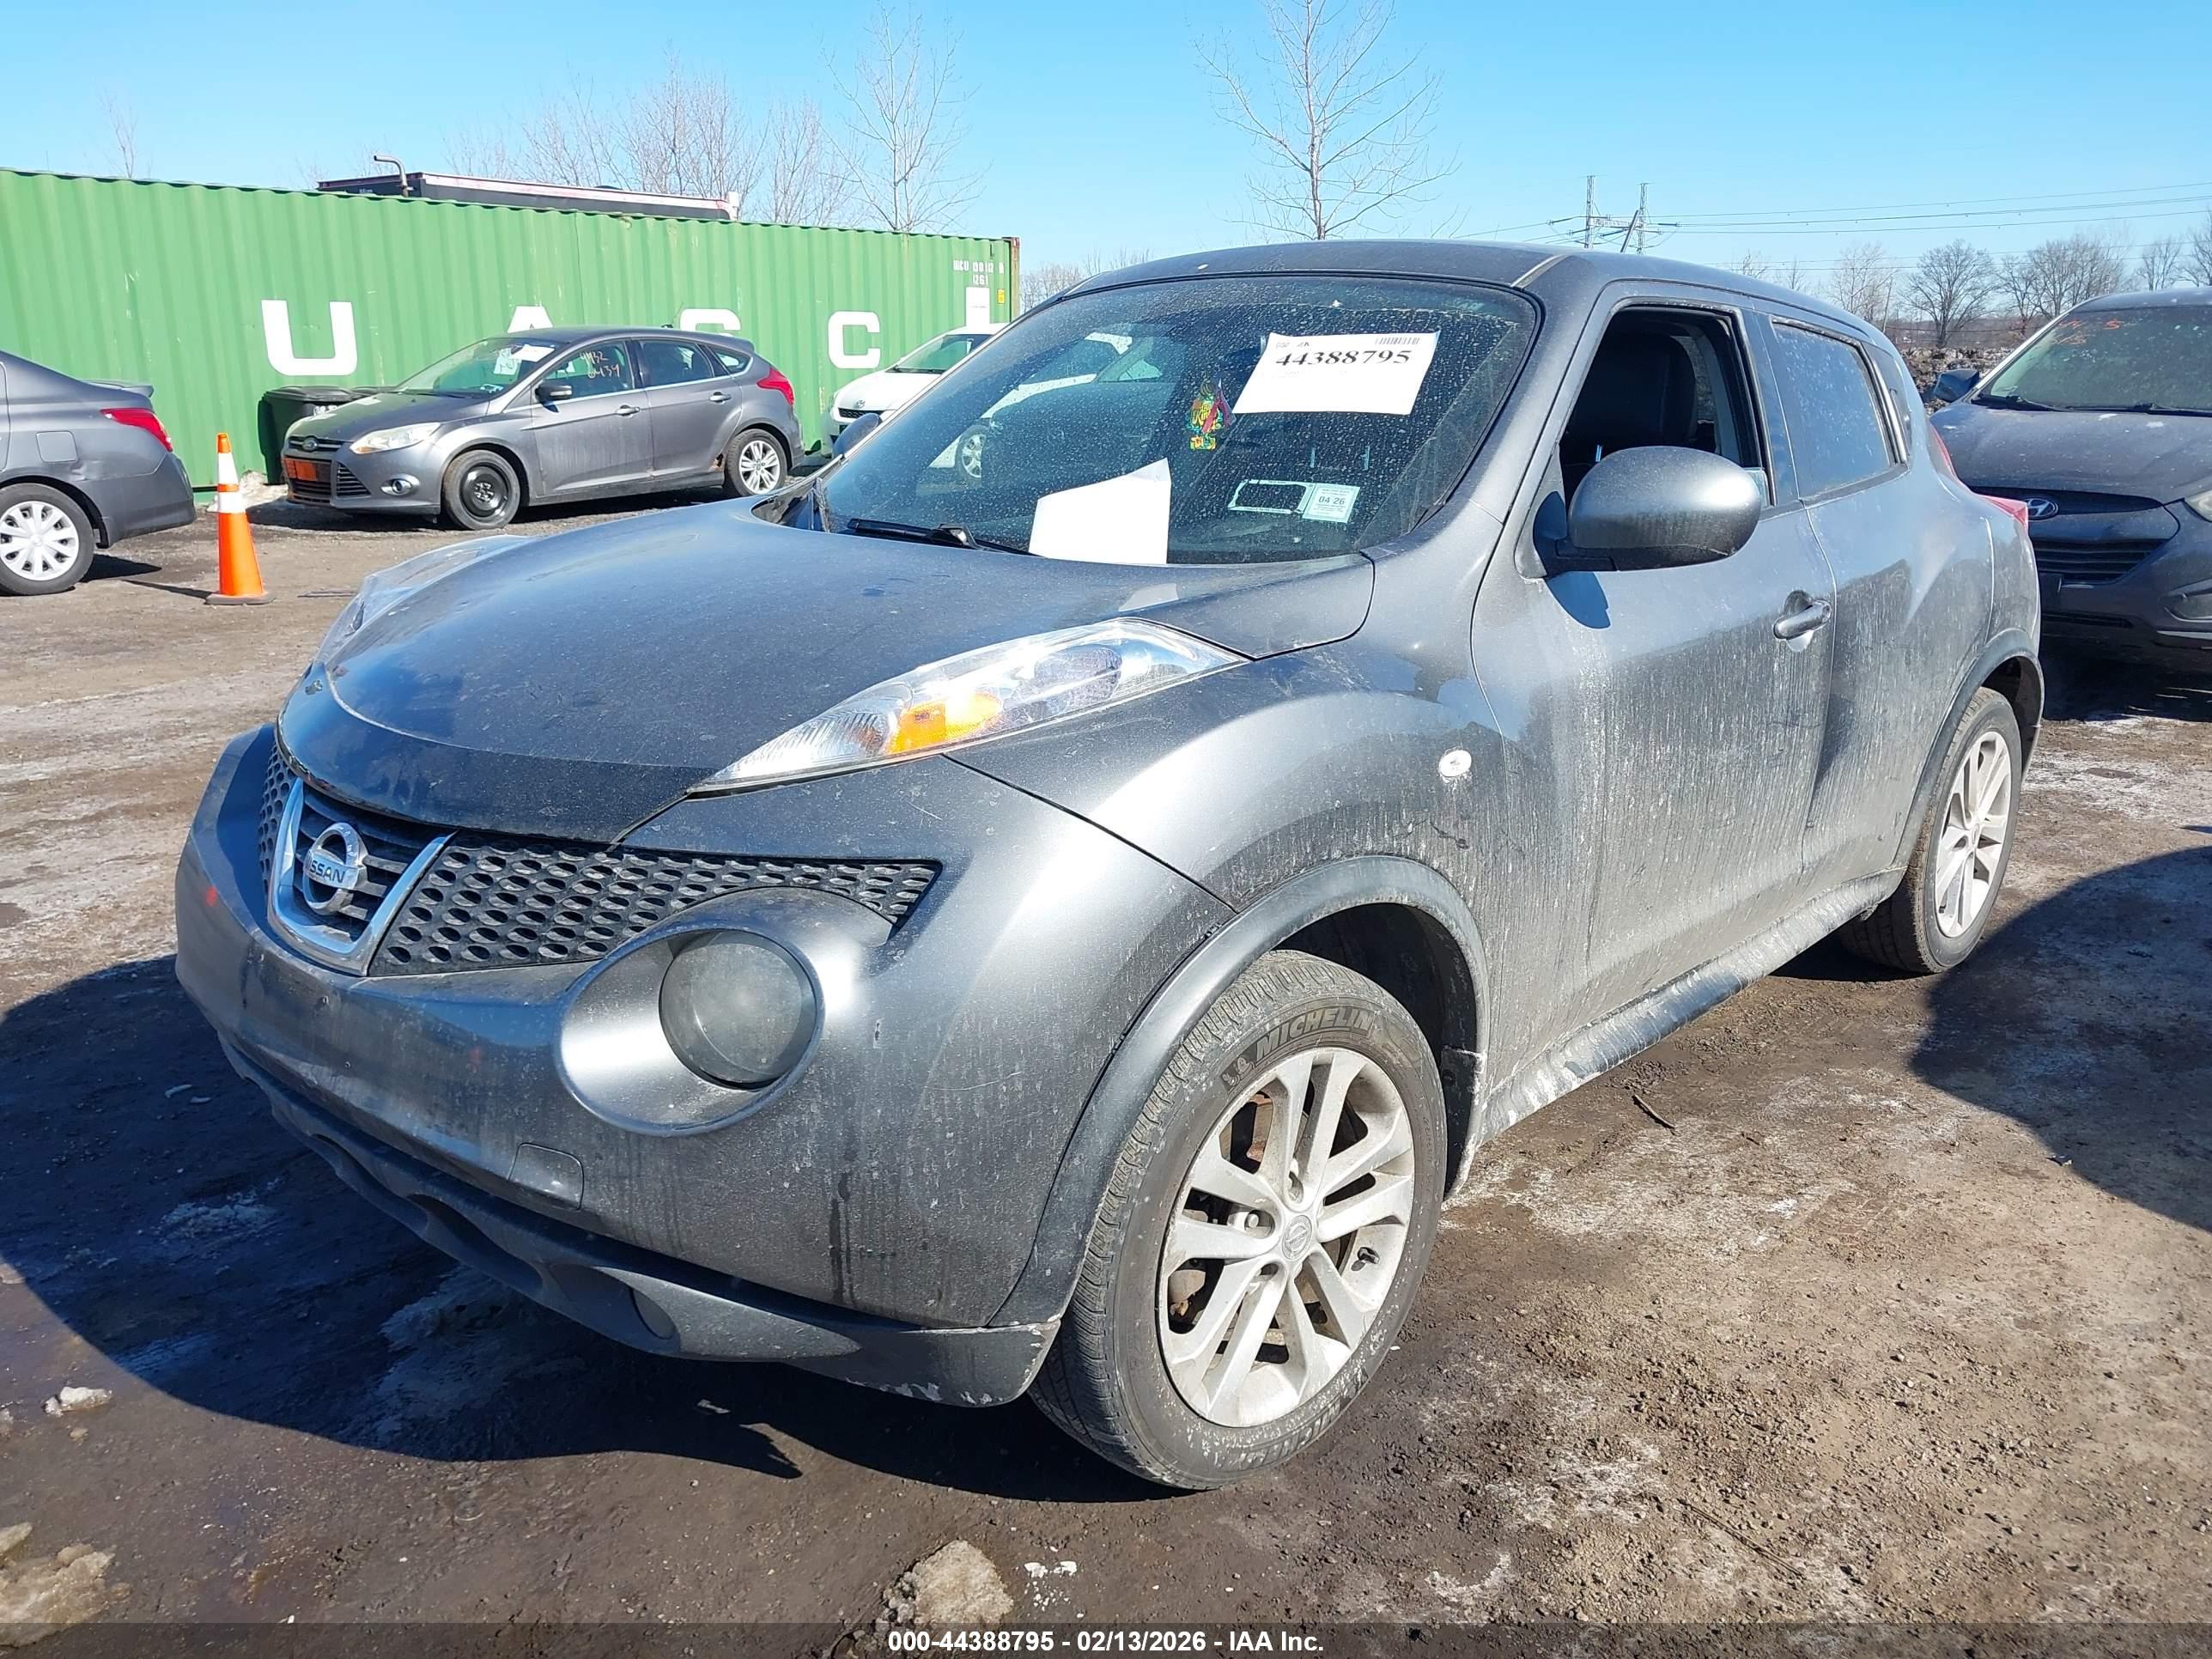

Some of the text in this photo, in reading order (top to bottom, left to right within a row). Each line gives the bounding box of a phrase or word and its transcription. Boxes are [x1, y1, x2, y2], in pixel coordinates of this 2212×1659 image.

[1275, 349, 1413, 367] 44388795
[1318, 495, 1346, 505] 04 26
[307, 856, 345, 884] SSAN
[1255, 1007, 1376, 1061] MICHELIN
